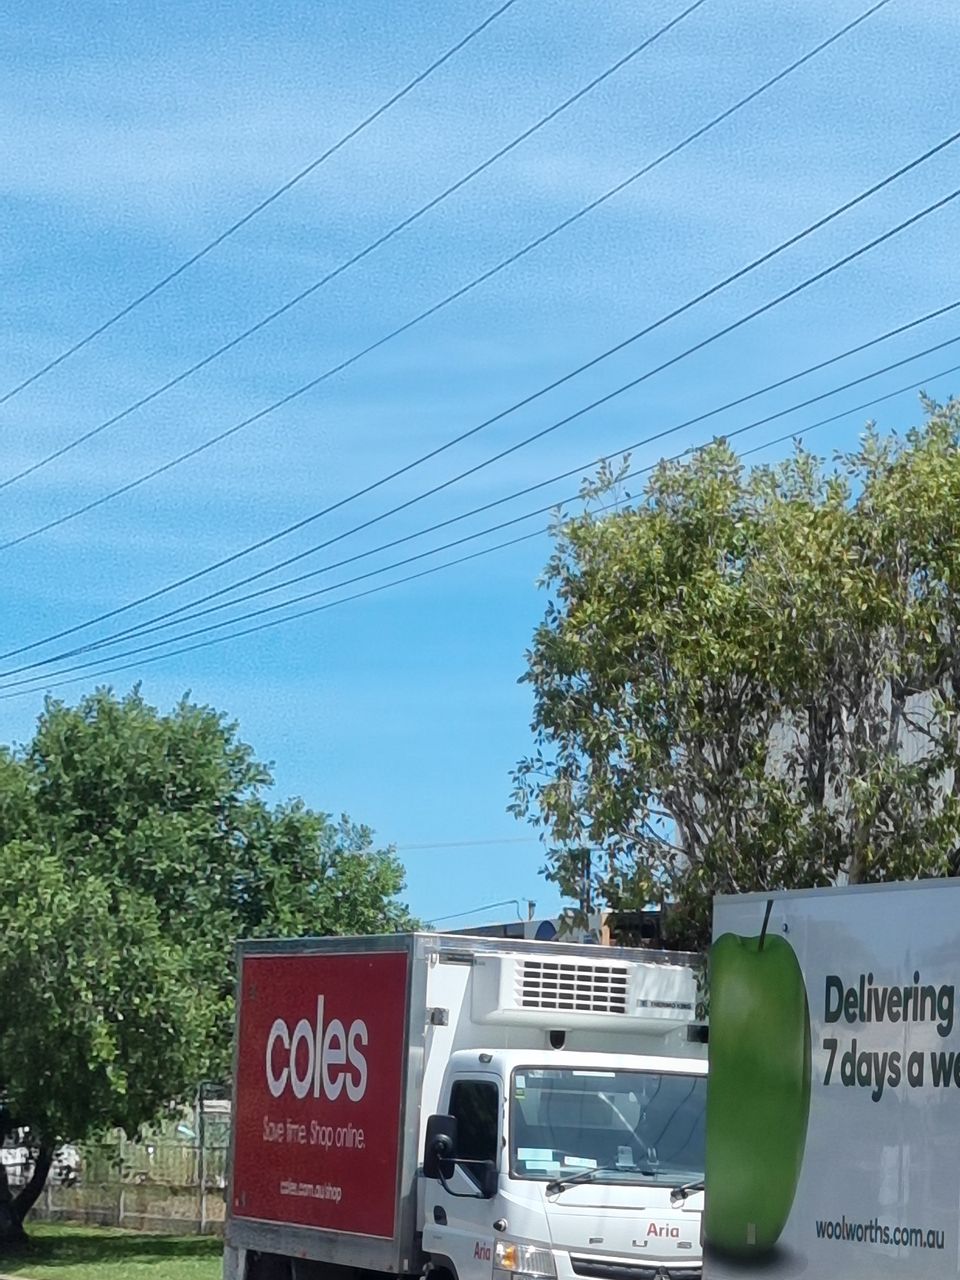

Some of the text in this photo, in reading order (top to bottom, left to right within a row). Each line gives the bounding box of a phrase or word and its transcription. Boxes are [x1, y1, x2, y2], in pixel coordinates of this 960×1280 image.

[824, 970, 955, 1037] Delivering
[265, 994, 369, 1102] coles
[823, 1038, 838, 1086] 7
[841, 1038, 901, 1103] days
[907, 1051, 924, 1088] a
[263, 1115, 284, 1143] Save
[309, 1120, 334, 1152] Shop
[335, 1122, 366, 1149] online.
[589, 1237, 692, 1249] FUS
[647, 1223, 680, 1238] Aria
[815, 1215, 945, 1249] woolworths.com.au
[474, 1241, 491, 1261] Aria
